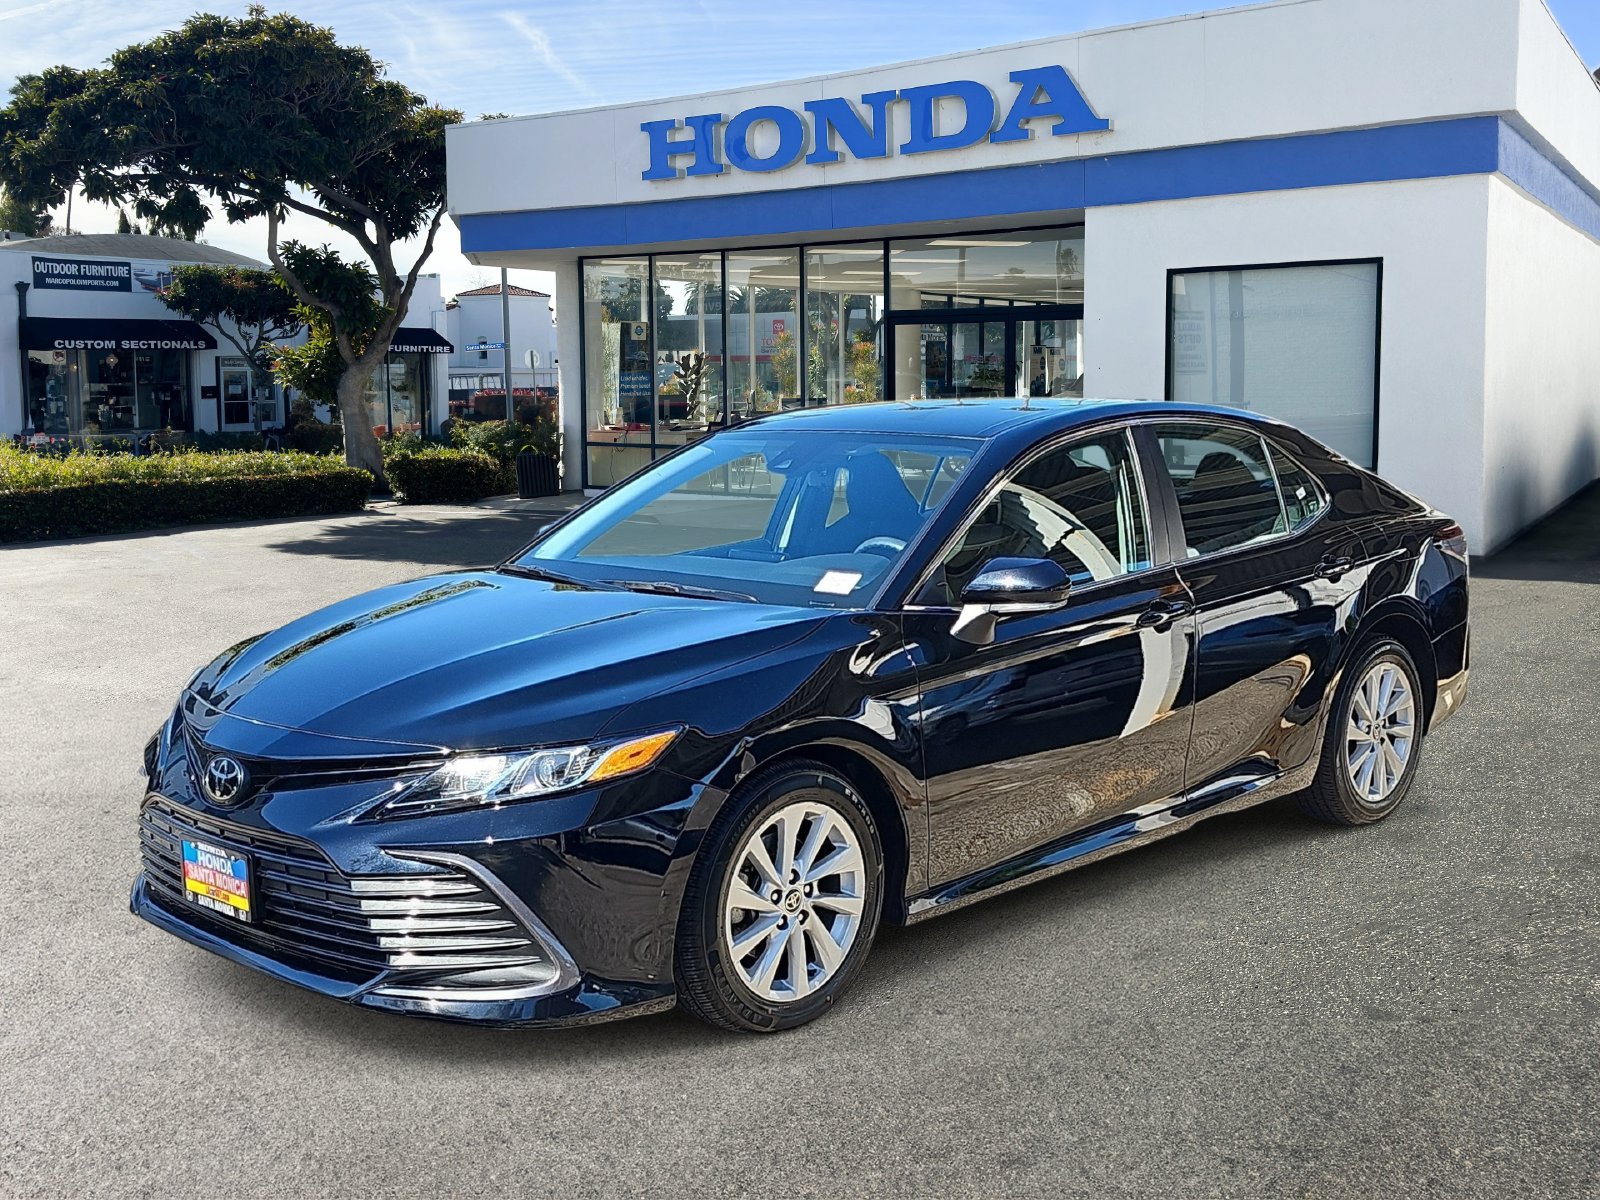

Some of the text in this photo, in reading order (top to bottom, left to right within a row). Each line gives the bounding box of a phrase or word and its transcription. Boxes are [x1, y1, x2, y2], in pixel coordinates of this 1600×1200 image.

[641, 65, 1112, 181] HONDA
[34, 261, 130, 277] OUTDOOR FURNITURE
[45, 277, 119, 287] MARCOPOLOIMPORTS.COM
[54, 339, 206, 349] CUSTOM SECTIONALS
[388, 344, 450, 353] FURNITURE
[196, 850, 234, 877] HONDA
[188, 864, 215, 886] SANTA
[214, 873, 247, 897] MONICA
